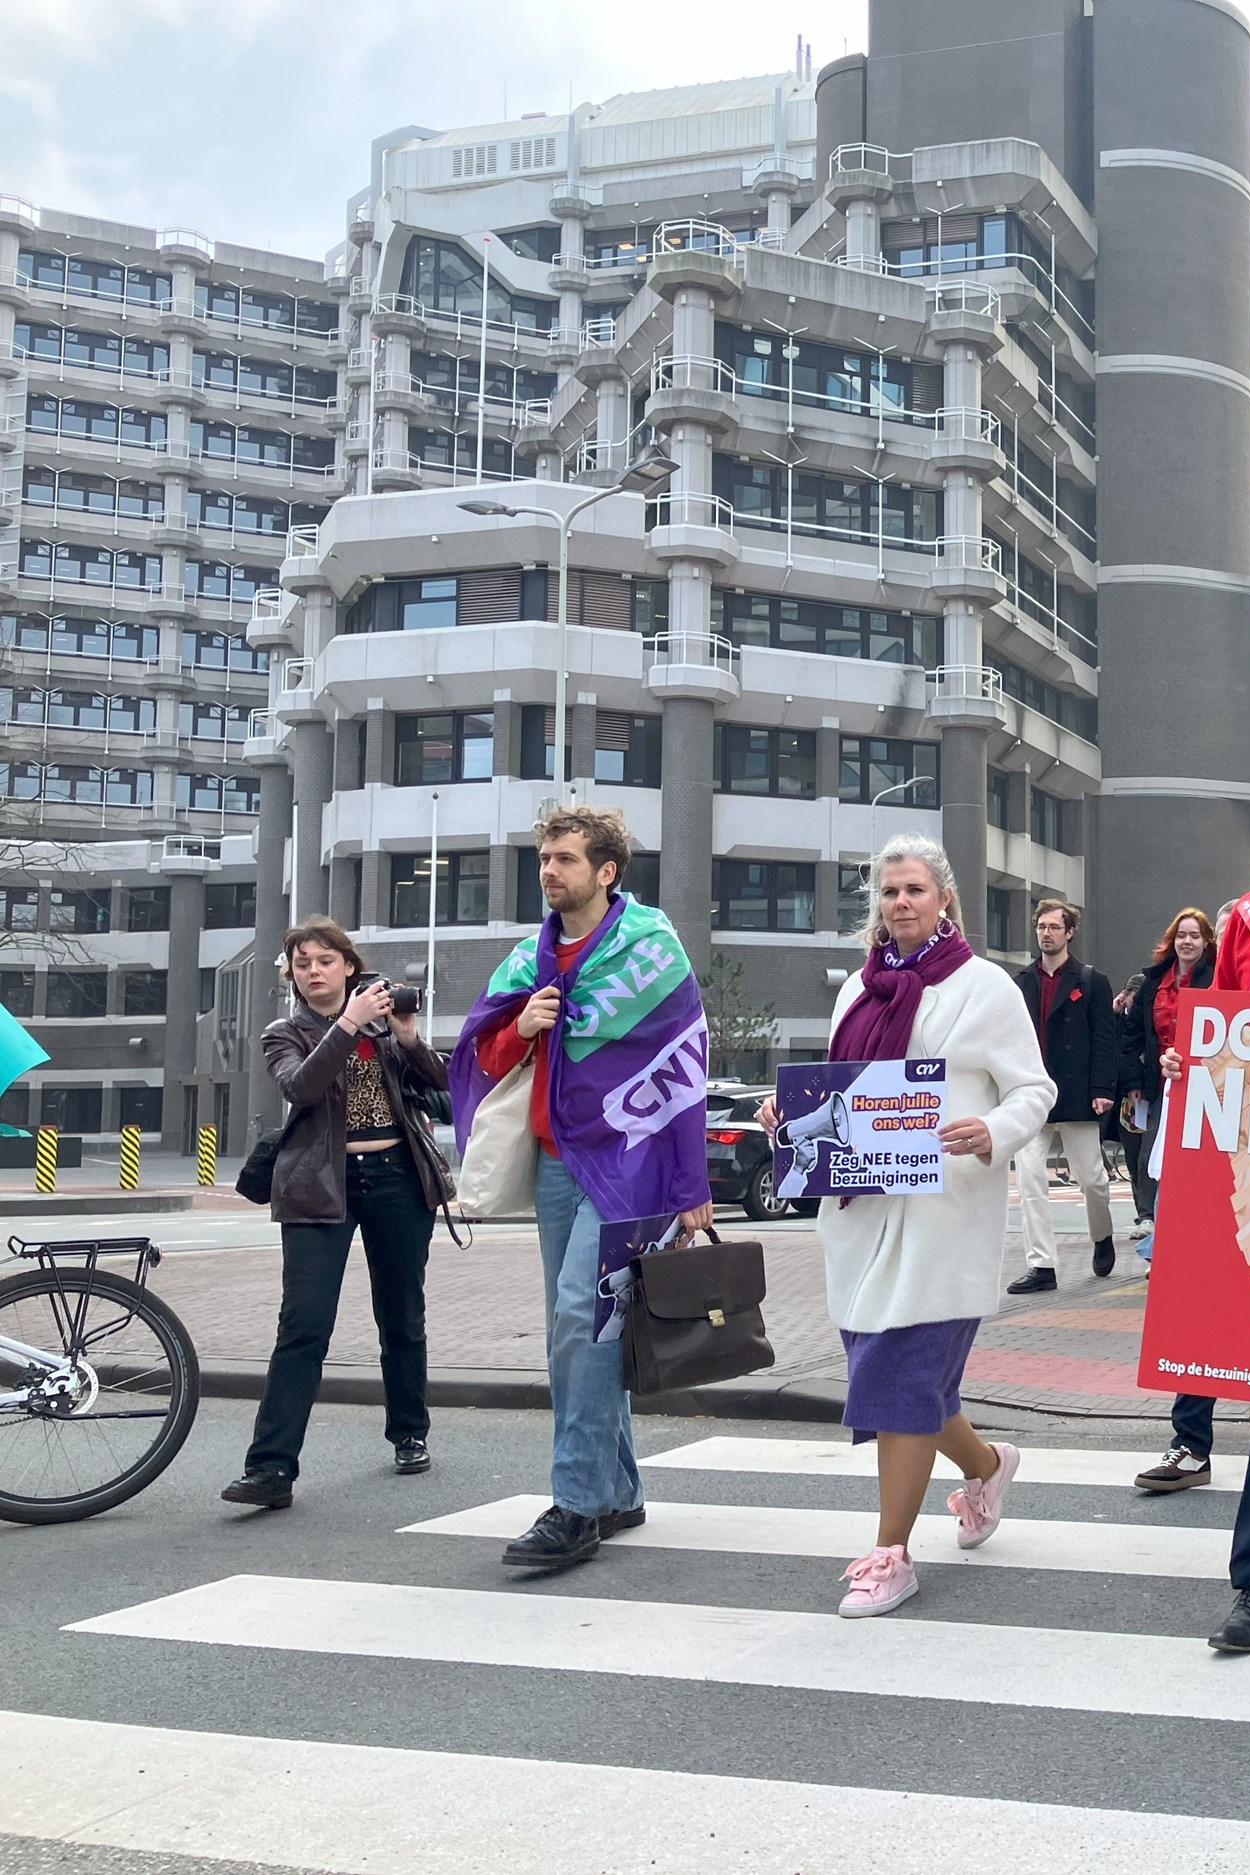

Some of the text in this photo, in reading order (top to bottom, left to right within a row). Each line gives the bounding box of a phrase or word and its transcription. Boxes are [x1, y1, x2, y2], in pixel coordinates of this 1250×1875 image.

[915, 1063, 940, 1076] CNV
[852, 1092, 941, 1112] Horen jullie
[872, 1112, 940, 1132] ons wel?
[831, 1152, 939, 1170] Zeg NEE tegen
[832, 1170, 939, 1187] bezuinigingen
[1158, 1358, 1186, 1376] Stop
[1187, 1362, 1203, 1376] de
